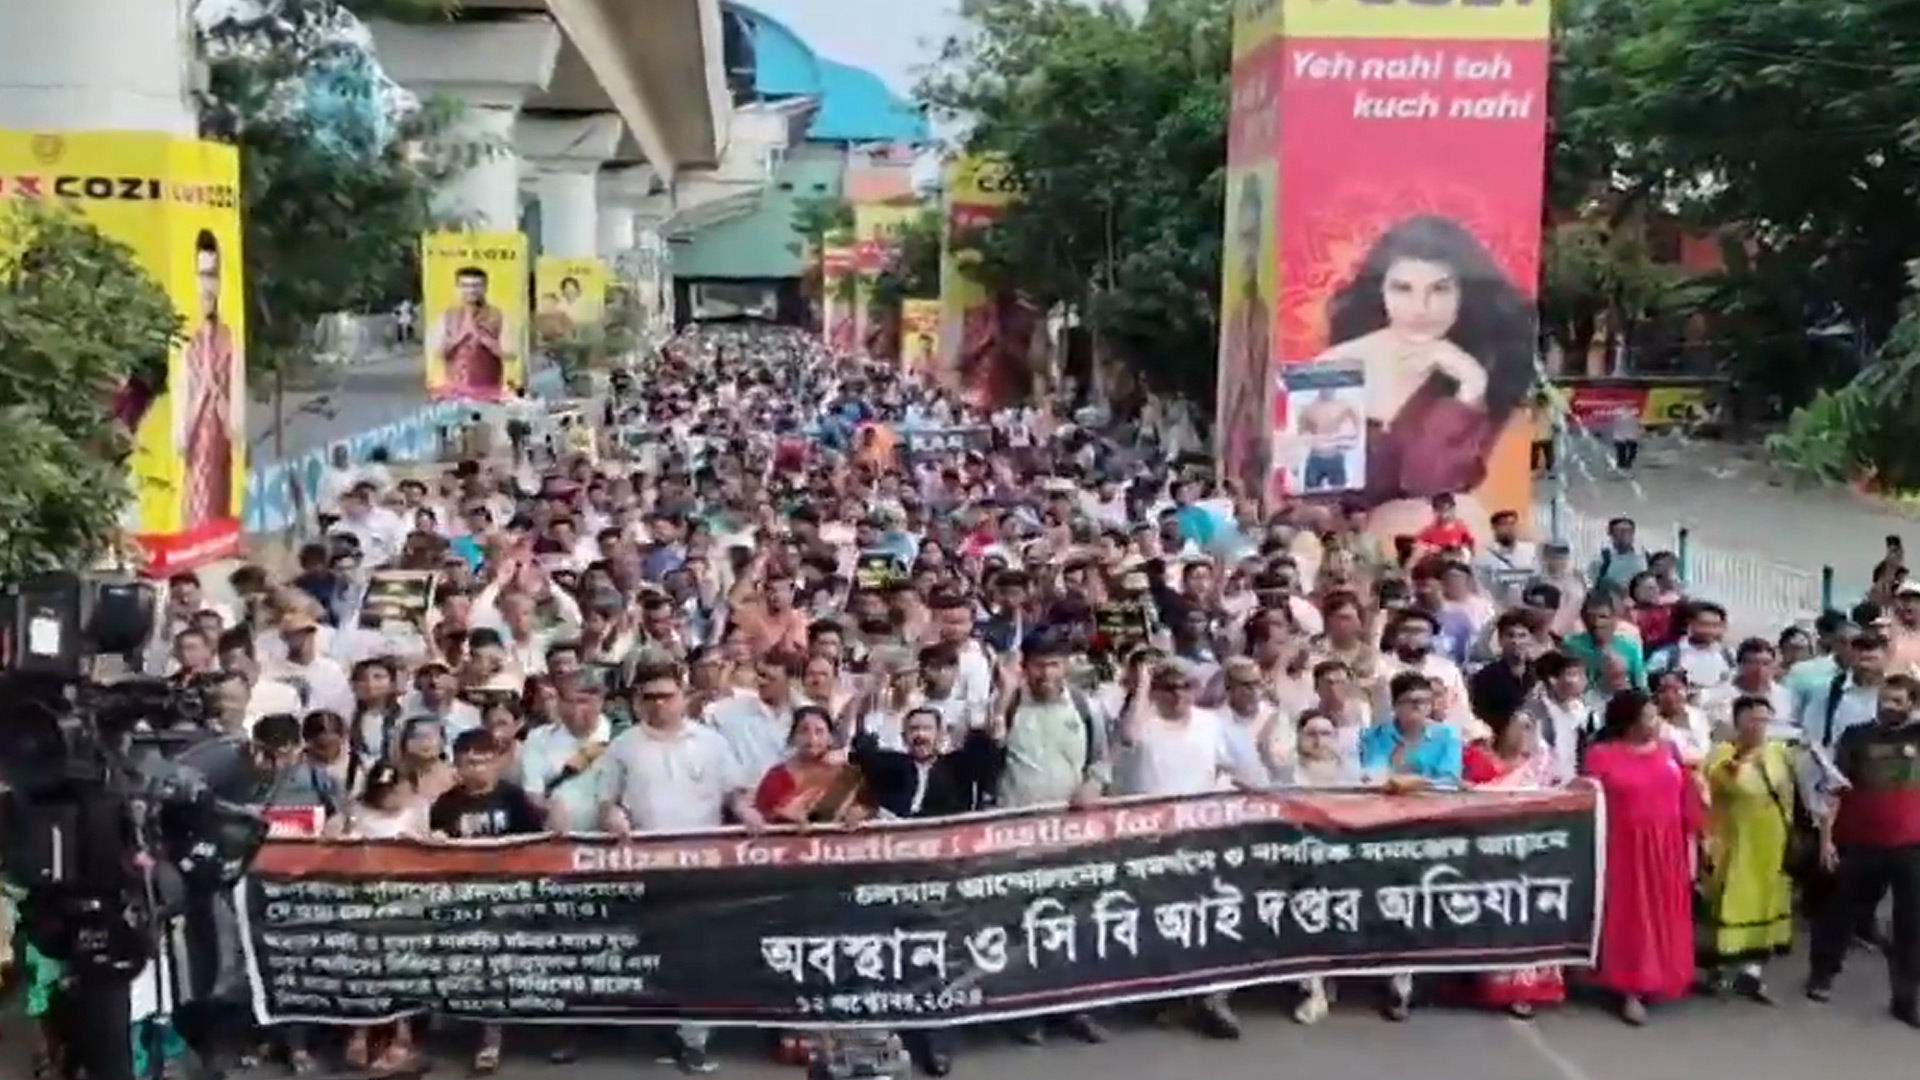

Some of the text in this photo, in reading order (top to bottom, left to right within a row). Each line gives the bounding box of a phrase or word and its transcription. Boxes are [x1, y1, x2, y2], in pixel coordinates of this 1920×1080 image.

[1292, 50, 1512, 80] Yeh nahi toh
[1353, 89, 1534, 118] kuch nahi
[54, 176, 160, 200] COZI
[735, 841, 788, 866] for
[797, 831, 942, 864] Justice
[972, 813, 1105, 853] Justice
[1114, 807, 1161, 838] for
[1250, 834, 1352, 865] নাগরিক
[760, 864, 1573, 982] অবস্থান ও সি বি আই দপ্তর অভিযান
